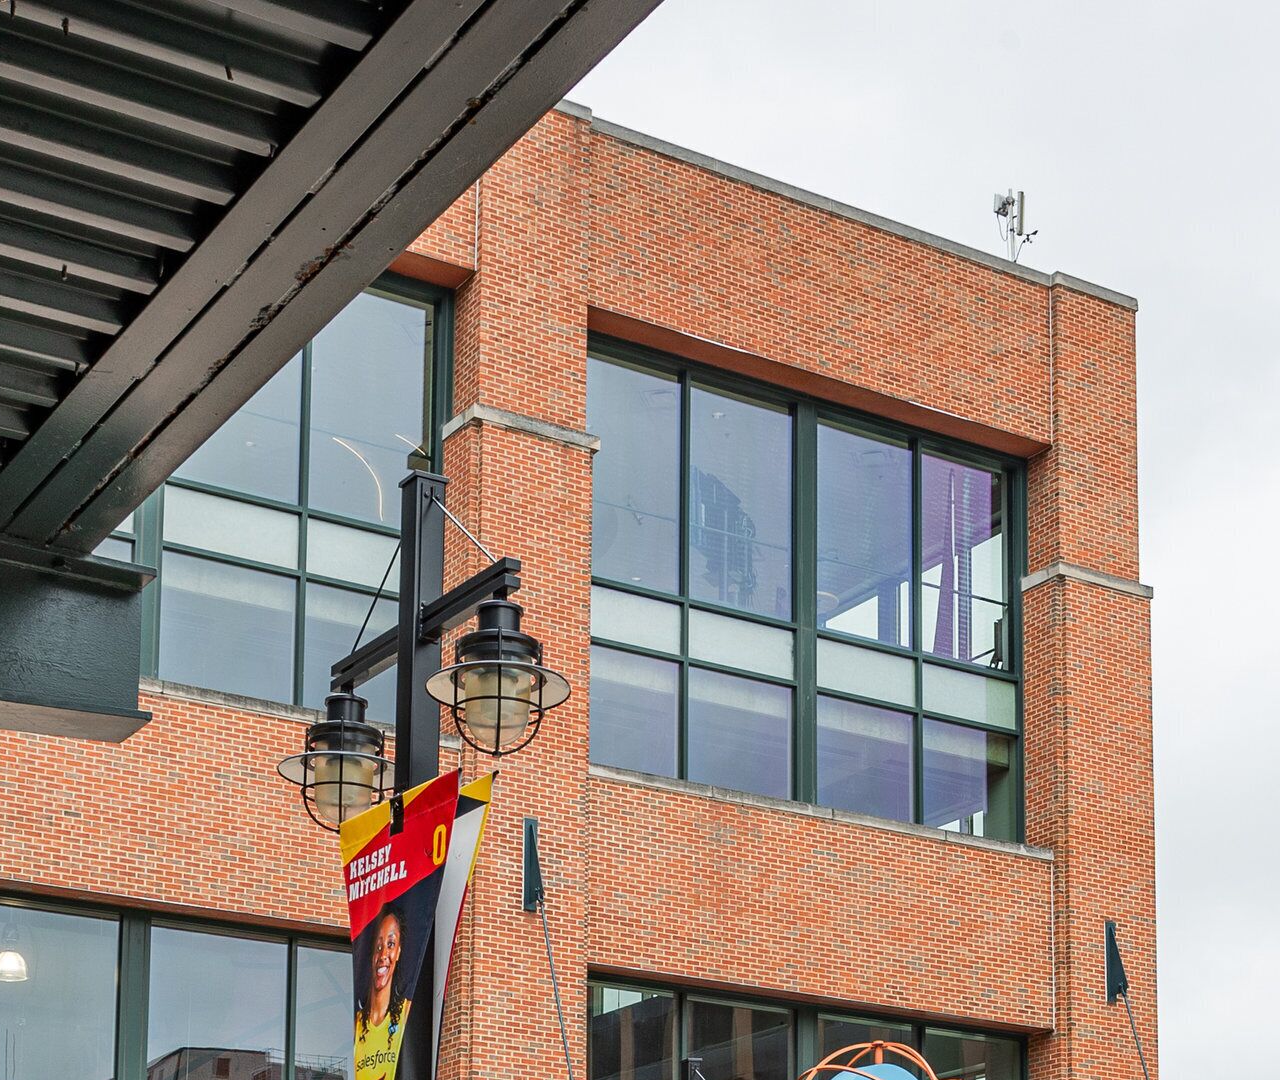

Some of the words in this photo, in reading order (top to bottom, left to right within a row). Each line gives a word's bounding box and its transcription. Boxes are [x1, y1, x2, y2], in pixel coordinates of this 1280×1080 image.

[349, 843, 392, 881] KELSEY
[432, 823, 447, 866] 0
[348, 860, 408, 903] MITCHELL
[356, 1049, 396, 1072] salesforce
